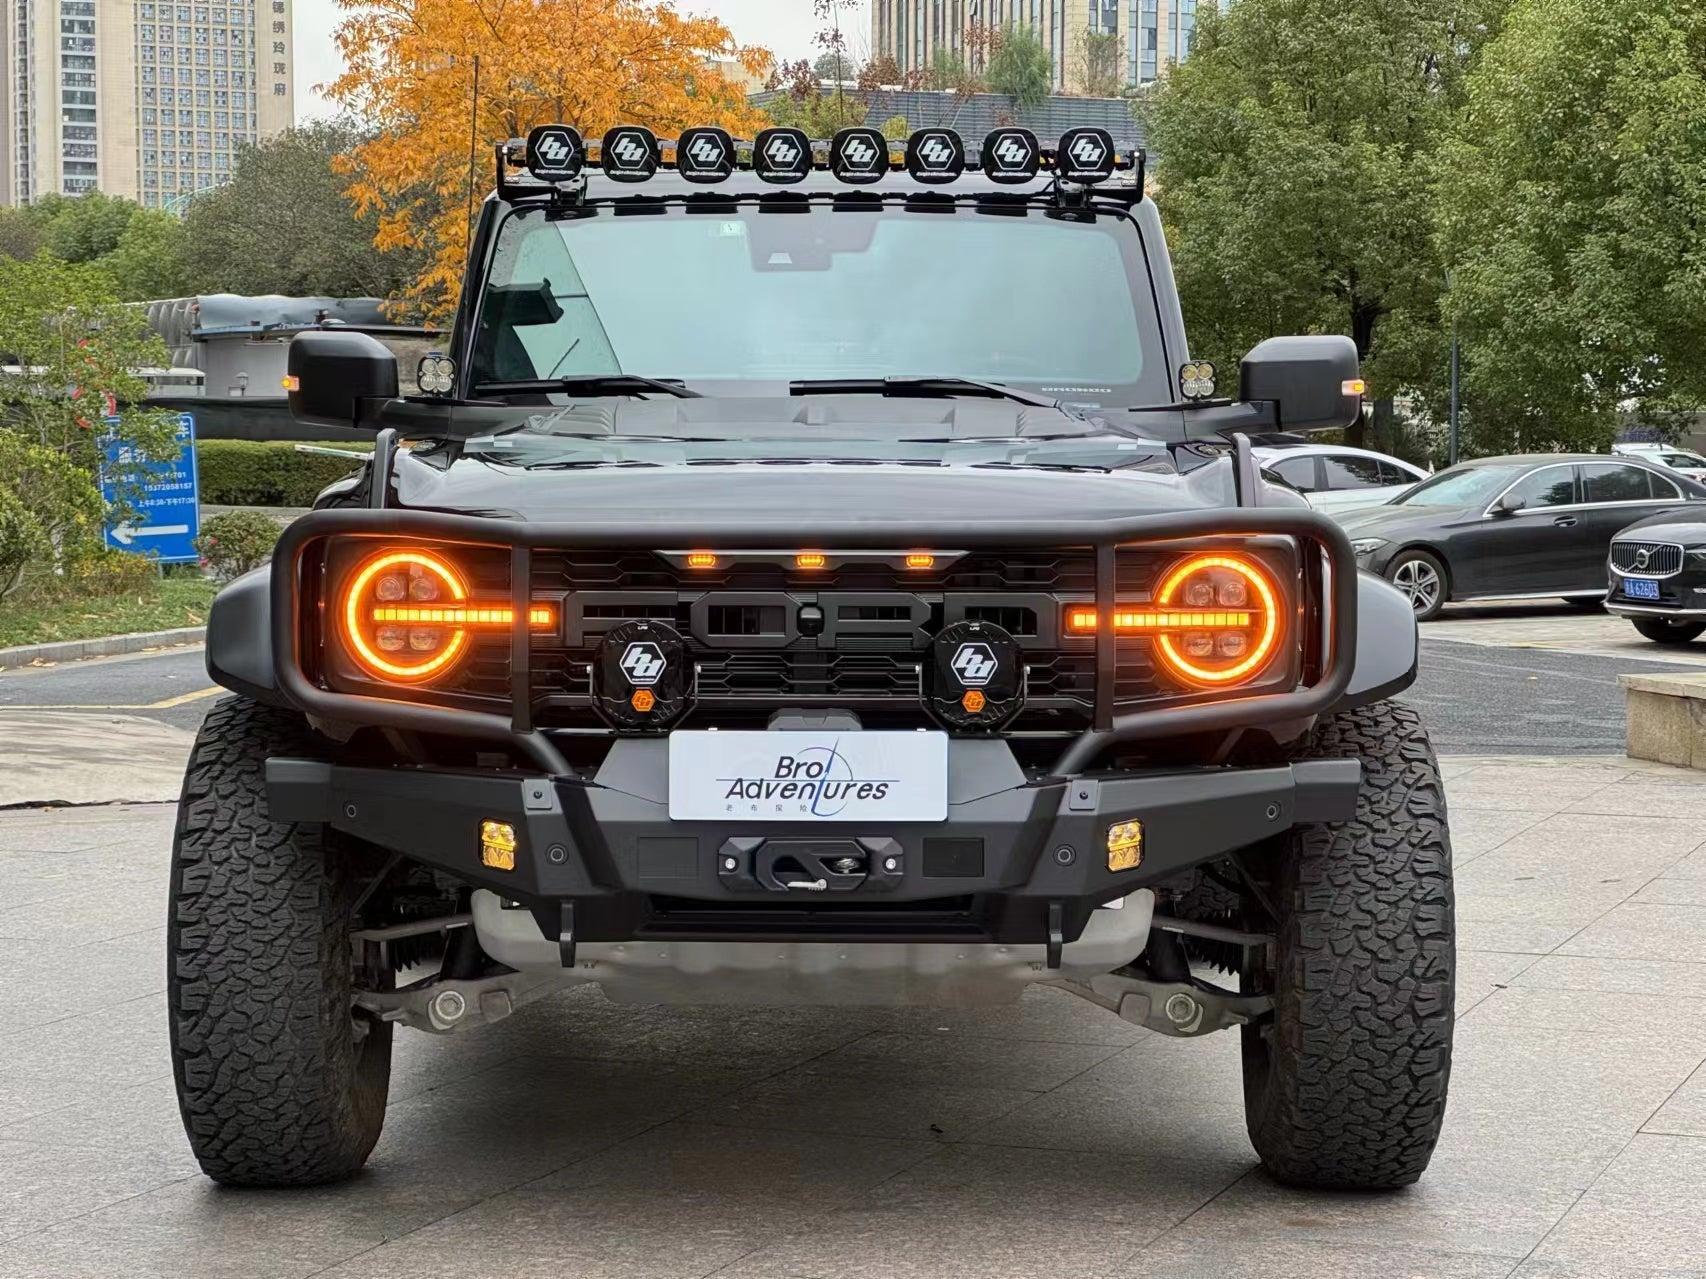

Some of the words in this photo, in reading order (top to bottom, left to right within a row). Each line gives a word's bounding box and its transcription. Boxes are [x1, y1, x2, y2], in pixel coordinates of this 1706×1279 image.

[272, 1, 287, 97] 锦绣玲珑府
[774, 756, 824, 779] Bro
[725, 777, 889, 800] Adventures
